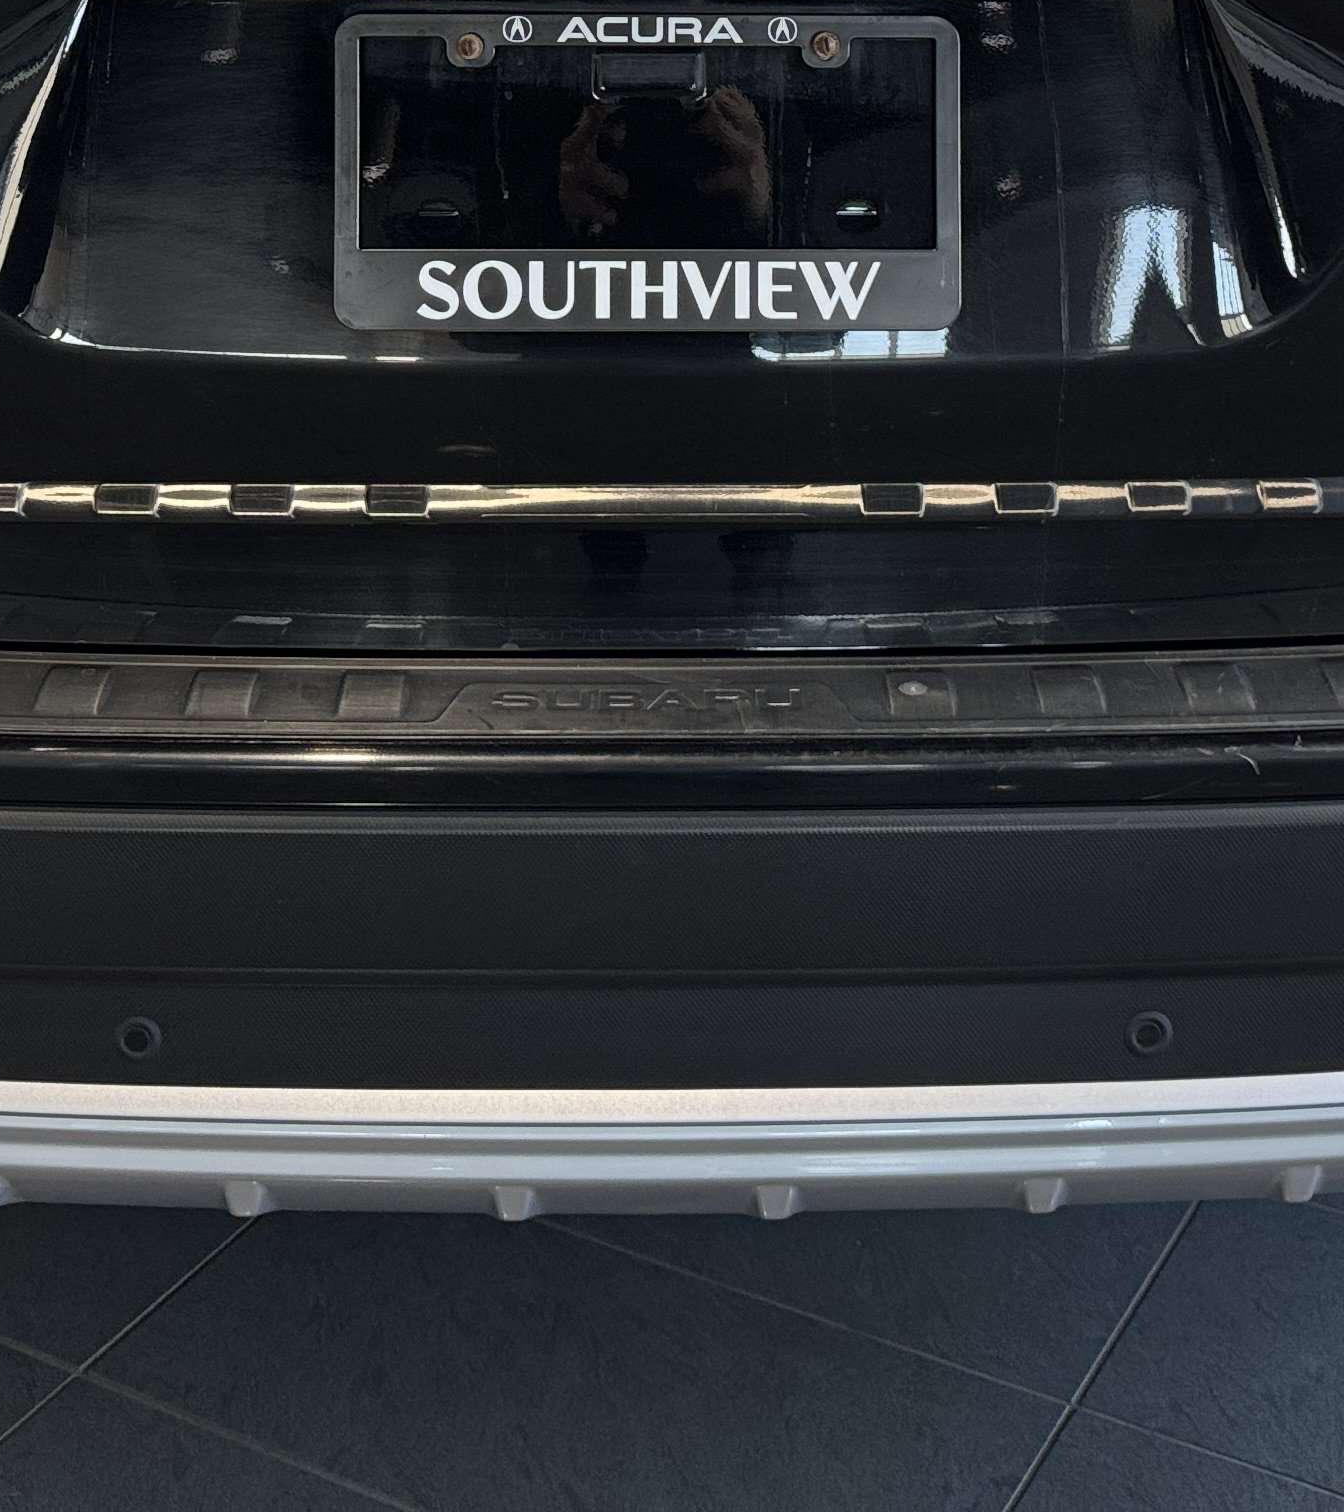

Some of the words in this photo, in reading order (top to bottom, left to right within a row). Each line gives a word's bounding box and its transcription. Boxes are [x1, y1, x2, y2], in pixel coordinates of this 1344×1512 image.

[555, 15, 744, 44] ACURA
[415, 259, 882, 321] SOUTHVIEW
[491, 687, 802, 712] SUBARU
